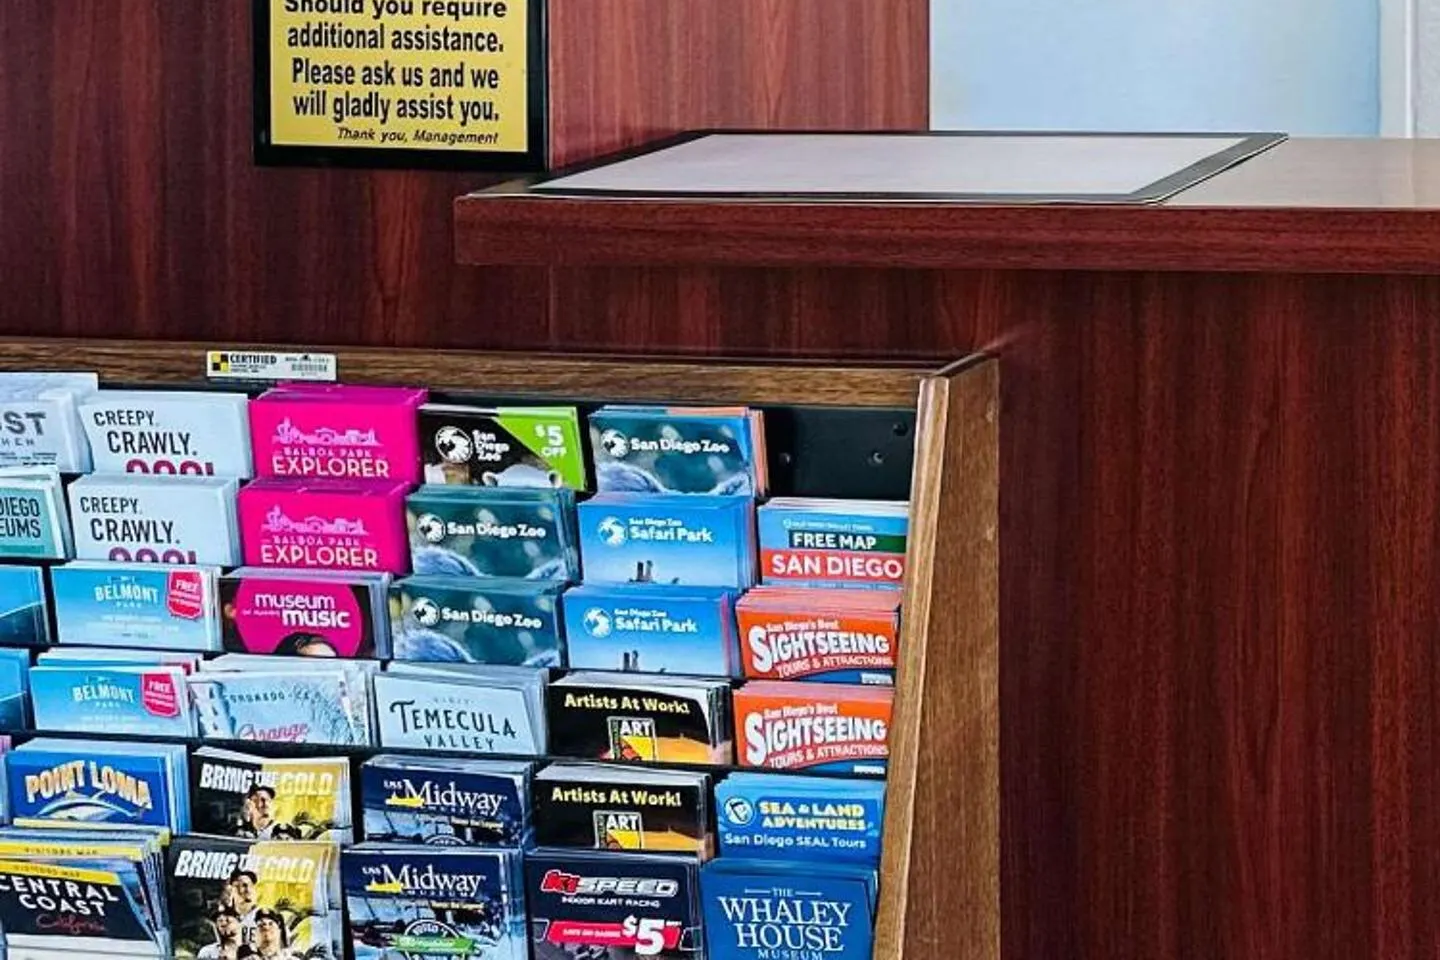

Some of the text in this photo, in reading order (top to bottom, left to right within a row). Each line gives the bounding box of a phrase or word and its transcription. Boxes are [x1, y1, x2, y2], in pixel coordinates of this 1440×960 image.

[288, 22, 504, 52] additional assistance.
[292, 57, 498, 89] Please ask us and we
[293, 90, 499, 126] will gladly assist you.
[337, 126, 498, 146] Thank you, Management
[107, 431, 197, 456] CRAWLY.
[472, 429, 496, 442] San
[475, 440, 510, 454] Diego
[478, 452, 501, 462] Zoo
[541, 447, 567, 457] OFF
[631, 439, 730, 455] San Diego Zoo
[272, 456, 389, 478] EXPLORER
[90, 518, 180, 544] CRAWLY.
[447, 523, 547, 538] San Diego Zoo
[629, 525, 713, 543] Safari Park
[792, 532, 877, 550] FREE MAP
[261, 544, 378, 567] EXPLORER
[771, 554, 903, 579] SAN DIEGO
[94, 585, 160, 604] BELMONT
[255, 594, 335, 609] museum
[282, 610, 350, 628] music
[442, 608, 542, 629] San Diego Zoo
[615, 617, 698, 634] Safari Park
[748, 624, 890, 673] SIGHTSEEING
[72, 684, 135, 703] BELMONT
[564, 692, 690, 715] Artists At Work!
[389, 699, 517, 739] TEMECULA
[619, 721, 651, 736] ART
[424, 736, 495, 752] VALLEY
[744, 711, 887, 767] SIGHTSEEING
[25, 758, 152, 809] POINT LOMA
[200, 763, 253, 793] BRING
[280, 772, 333, 796] GOLD
[403, 779, 503, 817] Midway
[551, 787, 682, 807] Artists At Work!
[759, 801, 795, 815] SEA
[812, 803, 864, 817] LAND
[606, 814, 639, 830] ART
[762, 816, 866, 831] ADVENTURES
[724, 833, 866, 848] San Diego SEAL Tours
[174, 850, 238, 880] BRING
[263, 857, 315, 883] GOLD
[381, 864, 482, 897] Midway
[578, 877, 678, 897] SPEED
[772, 888, 793, 897] THE
[19, 894, 105, 917] COAST
[717, 896, 852, 926] WHALEY
[733, 923, 844, 952] HOUSE
[758, 949, 823, 960] MUSEUM
